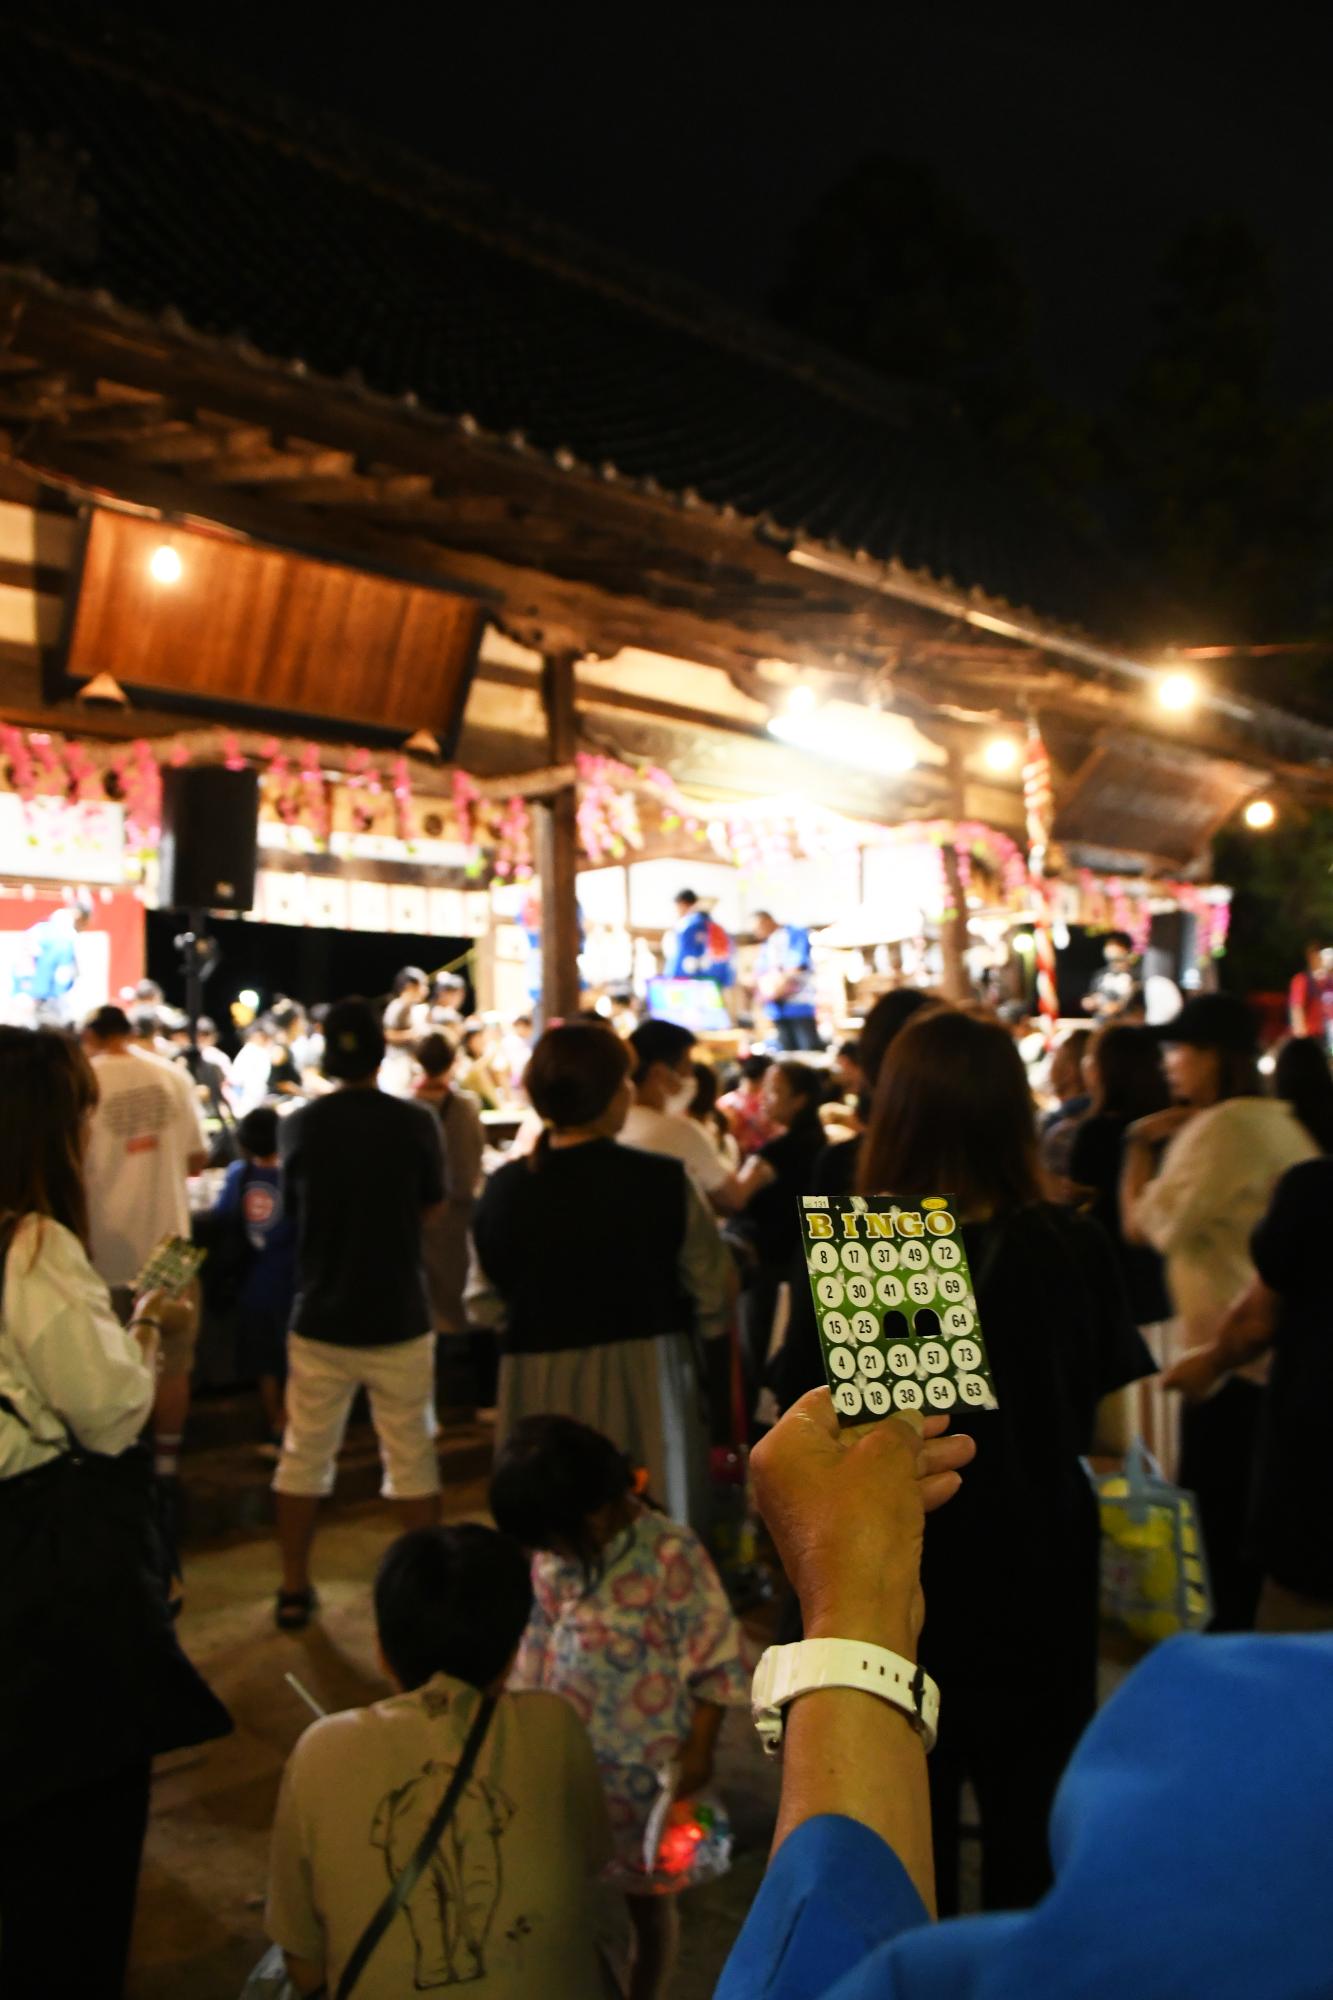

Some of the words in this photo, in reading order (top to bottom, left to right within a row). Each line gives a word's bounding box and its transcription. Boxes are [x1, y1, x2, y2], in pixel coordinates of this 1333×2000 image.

[805, 1211, 956, 1239] BINGO
[820, 1250, 828, 1264] 8
[848, 1250, 859, 1263] 17
[878, 1249, 890, 1263] 37
[908, 1248, 922, 1261] 49
[938, 1246, 953, 1260] 72
[826, 1285, 834, 1299] 2
[852, 1284, 867, 1298] 30
[884, 1284, 896, 1297] 41
[914, 1282, 928, 1296] 53
[945, 1280, 960, 1294] 69
[829, 1320, 842, 1334] 15
[858, 1320, 872, 1334] 25
[952, 1313, 967, 1328] 64
[838, 1356, 846, 1370] 4
[864, 1355, 876, 1369] 21
[894, 1353, 908, 1368] 31
[927, 1350, 940, 1365] 57
[958, 1348, 974, 1362] 73
[842, 1392, 855, 1406] 13
[870, 1390, 883, 1406] 18
[900, 1388, 916, 1403] 38
[933, 1385, 949, 1400] 54
[966, 1382, 982, 1396] 63
